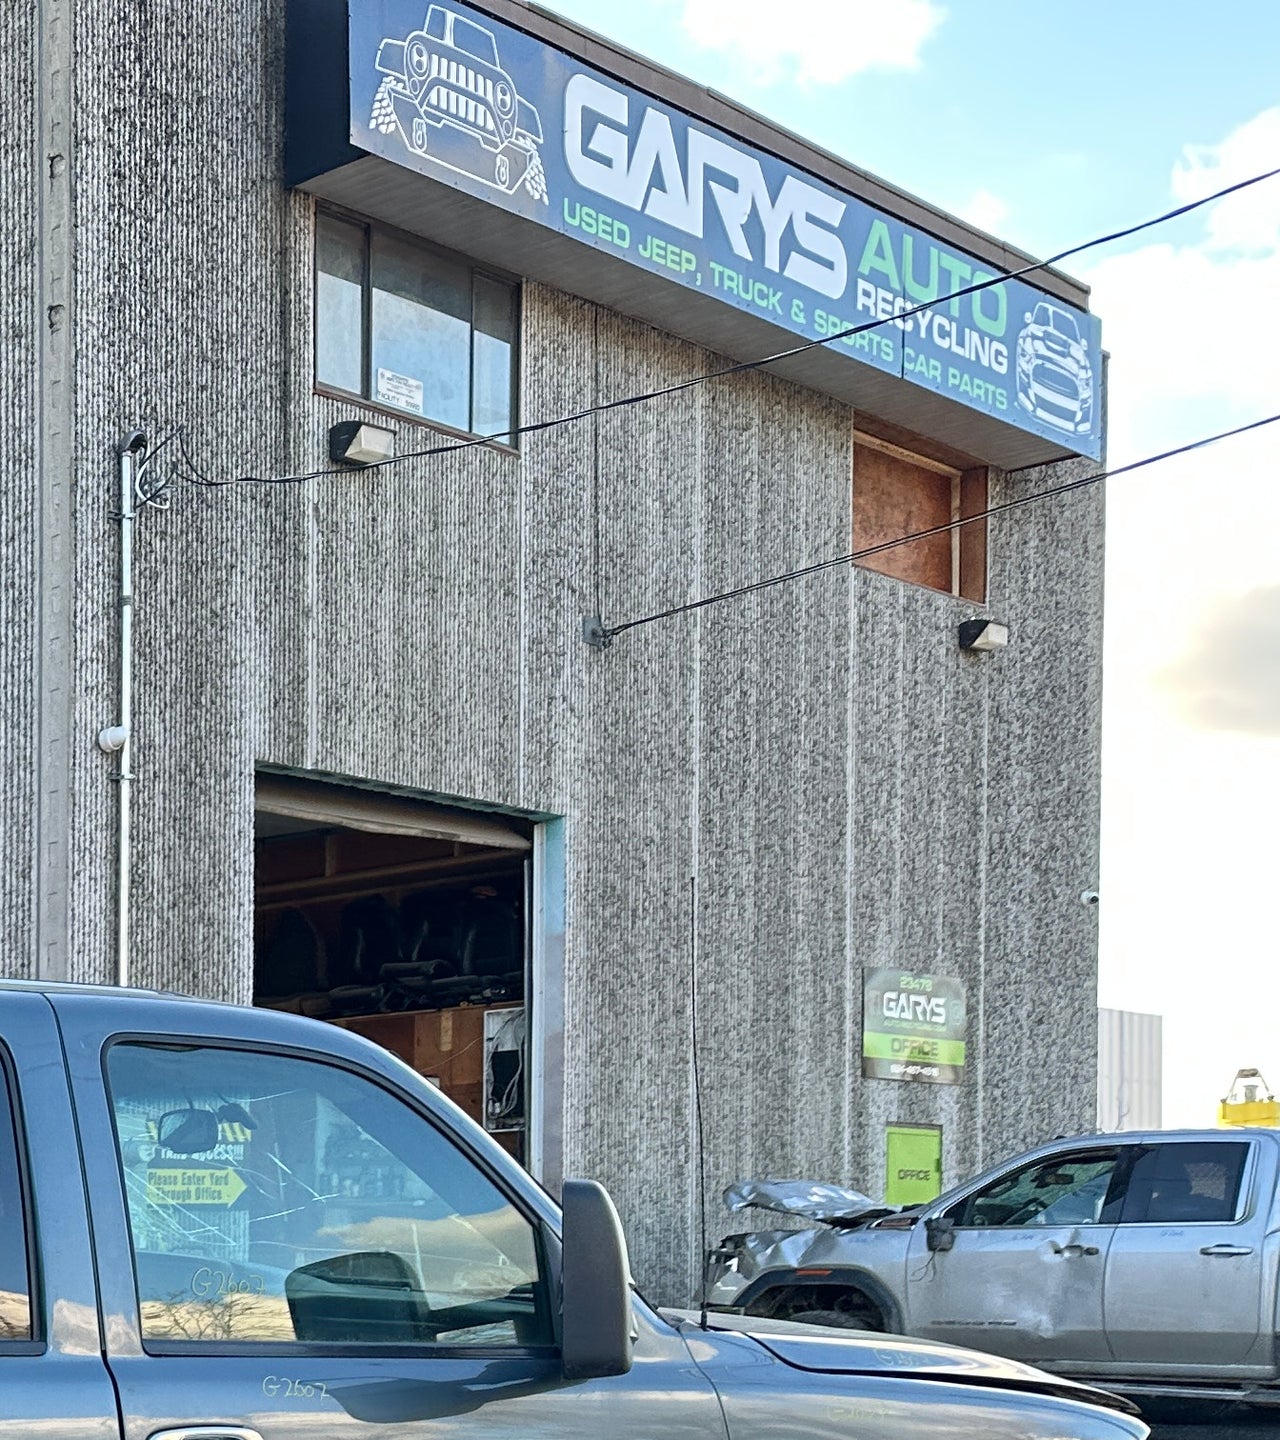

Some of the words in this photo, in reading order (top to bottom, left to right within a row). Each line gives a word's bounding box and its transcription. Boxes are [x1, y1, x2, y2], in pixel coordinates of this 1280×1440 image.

[564, 72, 847, 300] GARYS
[857, 218, 1009, 338] AUTO
[562, 197, 630, 250] USED
[637, 234, 703, 285] JEEP,
[709, 261, 784, 318] TRUCK
[790, 300, 806, 323] &
[814, 309, 894, 363] SPORTS
[904, 349, 942, 384] CAR
[947, 364, 1009, 412] PARTS
[855, 277, 1009, 375] RECYCLING
[883, 991, 948, 1024] GARYS
[891, 1037, 939, 1057] OFFICE
[147, 1172, 178, 1186] Please
[181, 1172, 206, 1186] Enter
[208, 1172, 230, 1186] Yard
[897, 1169, 931, 1181] OFFICE
[195, 1187, 223, 1201] Office
[191, 1267, 268, 1296] G2607
[262, 1373, 331, 1400] G2607
